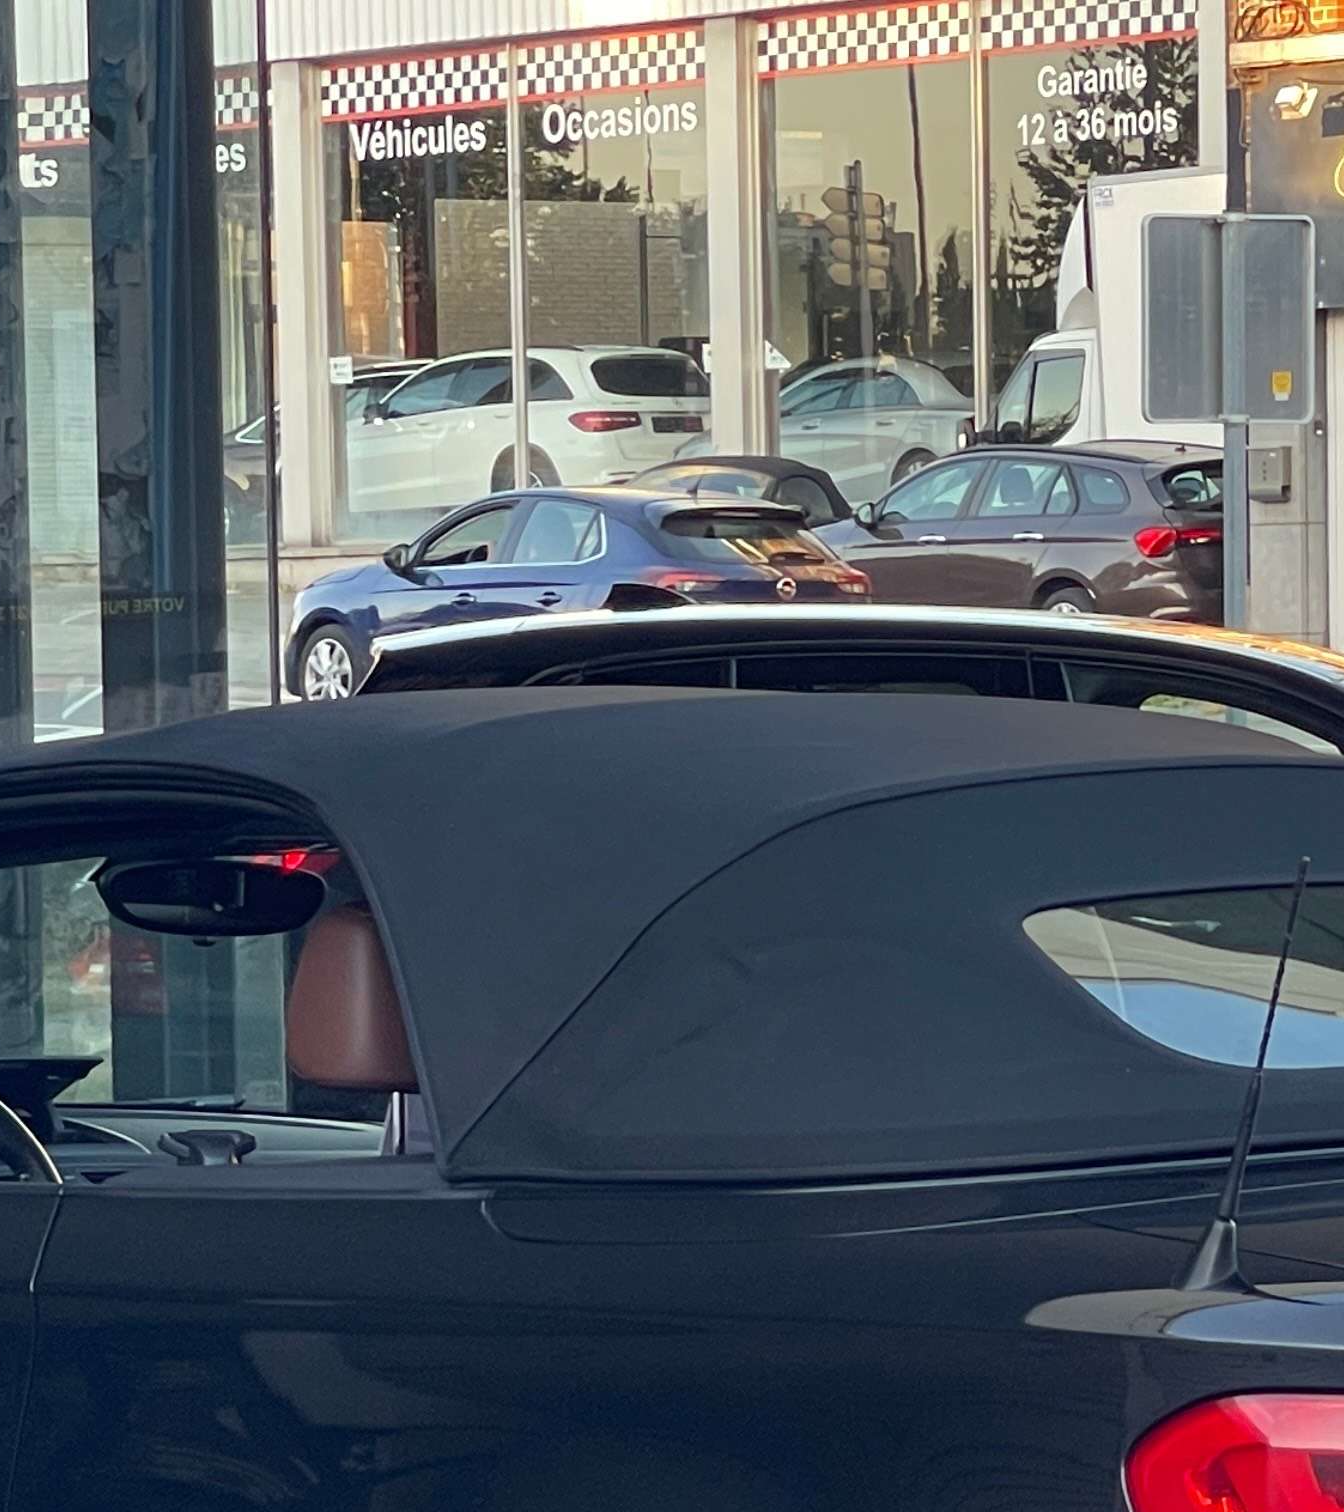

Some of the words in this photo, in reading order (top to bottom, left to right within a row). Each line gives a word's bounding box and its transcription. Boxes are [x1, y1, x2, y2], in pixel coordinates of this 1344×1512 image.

[1037, 56, 1148, 98] Garantie
[350, 114, 487, 161] Véhicules
[542, 96, 698, 144] Occasions
[1016, 112, 1046, 146] 12
[1053, 110, 1068, 143] à
[1076, 107, 1106, 141] 36
[1114, 100, 1178, 137] mois
